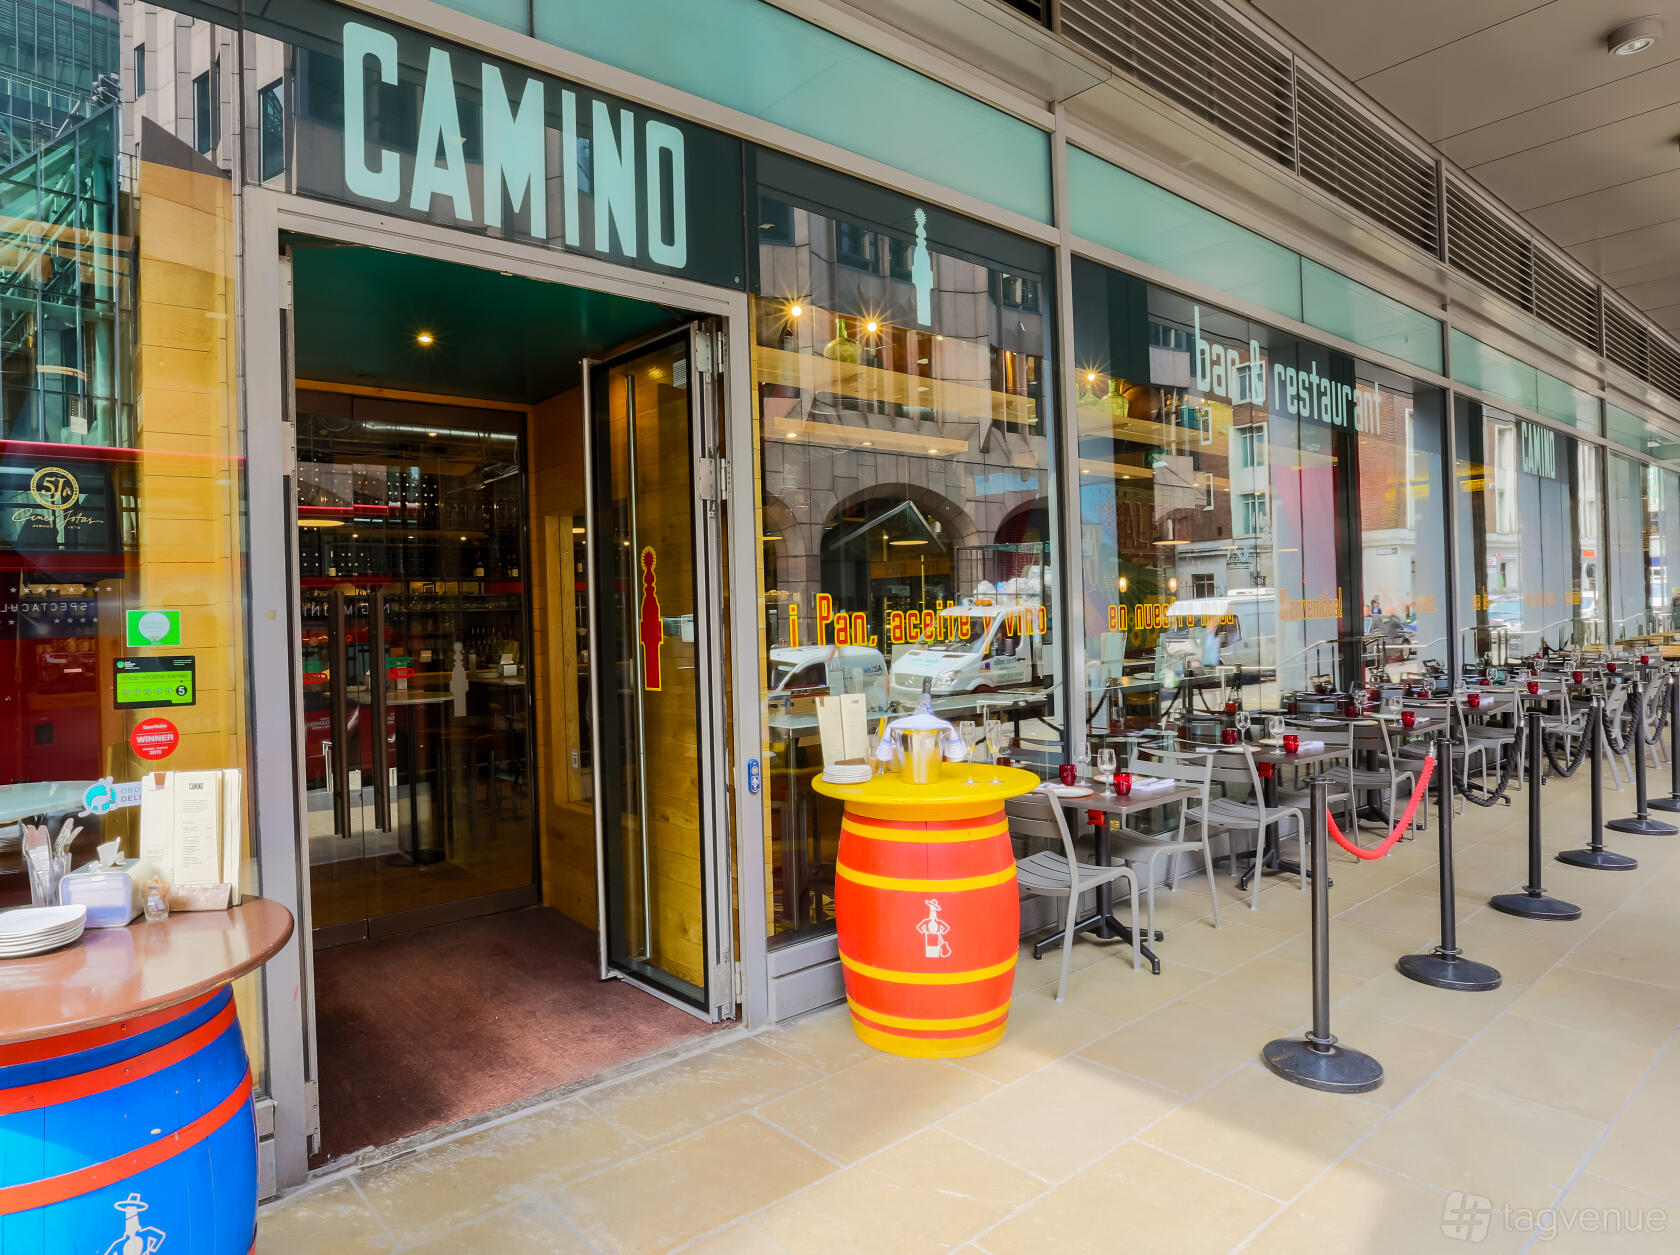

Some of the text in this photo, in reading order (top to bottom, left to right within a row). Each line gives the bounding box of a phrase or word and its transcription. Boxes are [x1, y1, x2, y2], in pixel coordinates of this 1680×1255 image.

[343, 21, 687, 269] CAMINO
[1194, 305, 1240, 398] bar
[1273, 361, 1382, 435] restaurant
[1521, 421, 1556, 480] CAMINO
[816, 592, 878, 648] Pan,
[890, 600, 971, 644] aceite
[1005, 599, 1047, 637] vino
[1108, 604, 1128, 631] en
[178, 686, 186, 696] 5
[136, 734, 174, 743] WINNER
